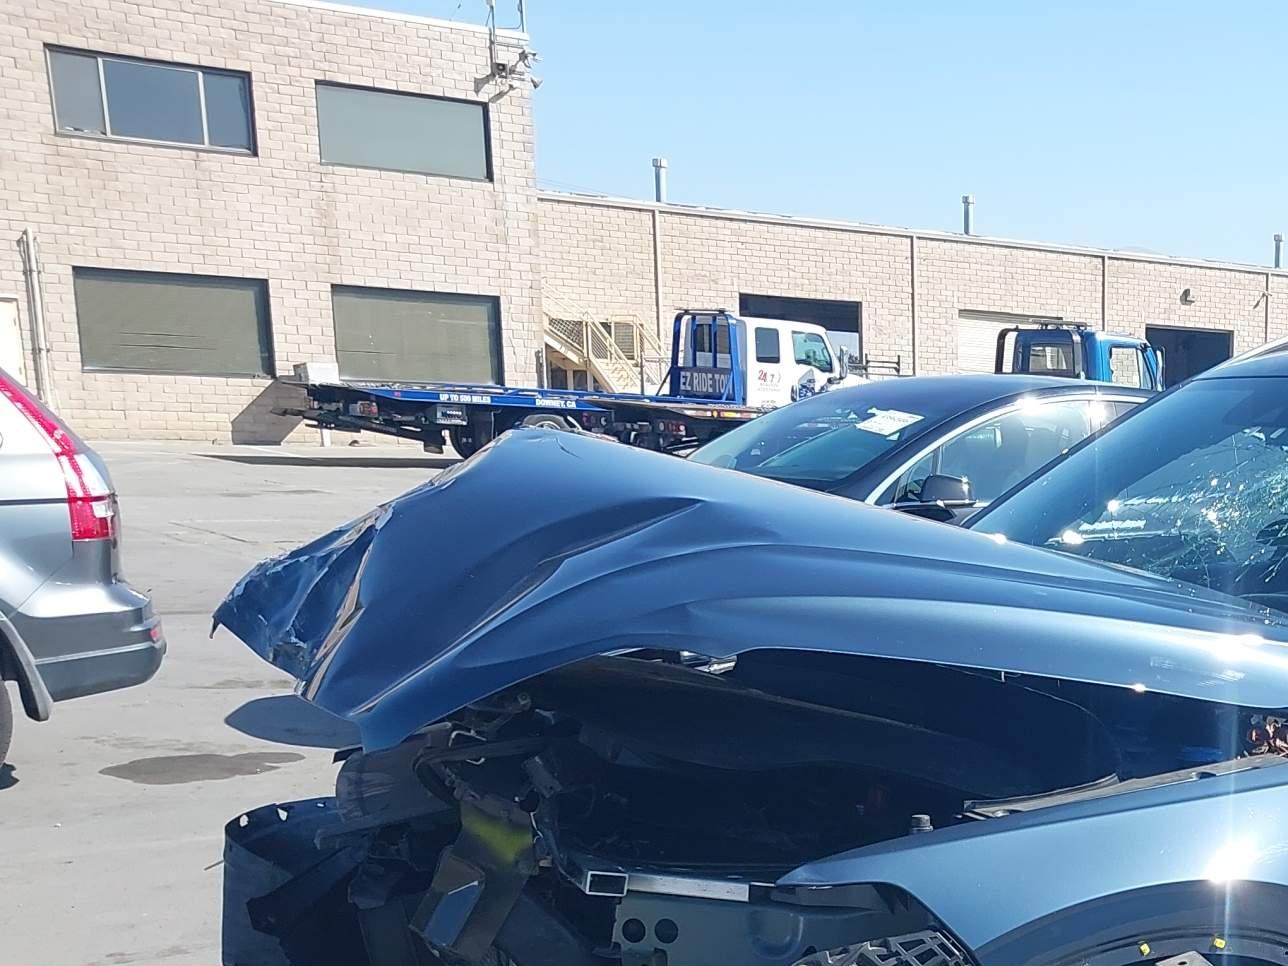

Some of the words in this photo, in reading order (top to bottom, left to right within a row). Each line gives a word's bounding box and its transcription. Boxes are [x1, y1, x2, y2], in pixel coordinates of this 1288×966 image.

[680, 371, 692, 390] EZ
[693, 372, 714, 393] RIDE
[439, 393, 450, 402] UP
[450, 393, 459, 402] TO
[472, 394, 492, 404] MILES
[567, 400, 577, 409] CA
